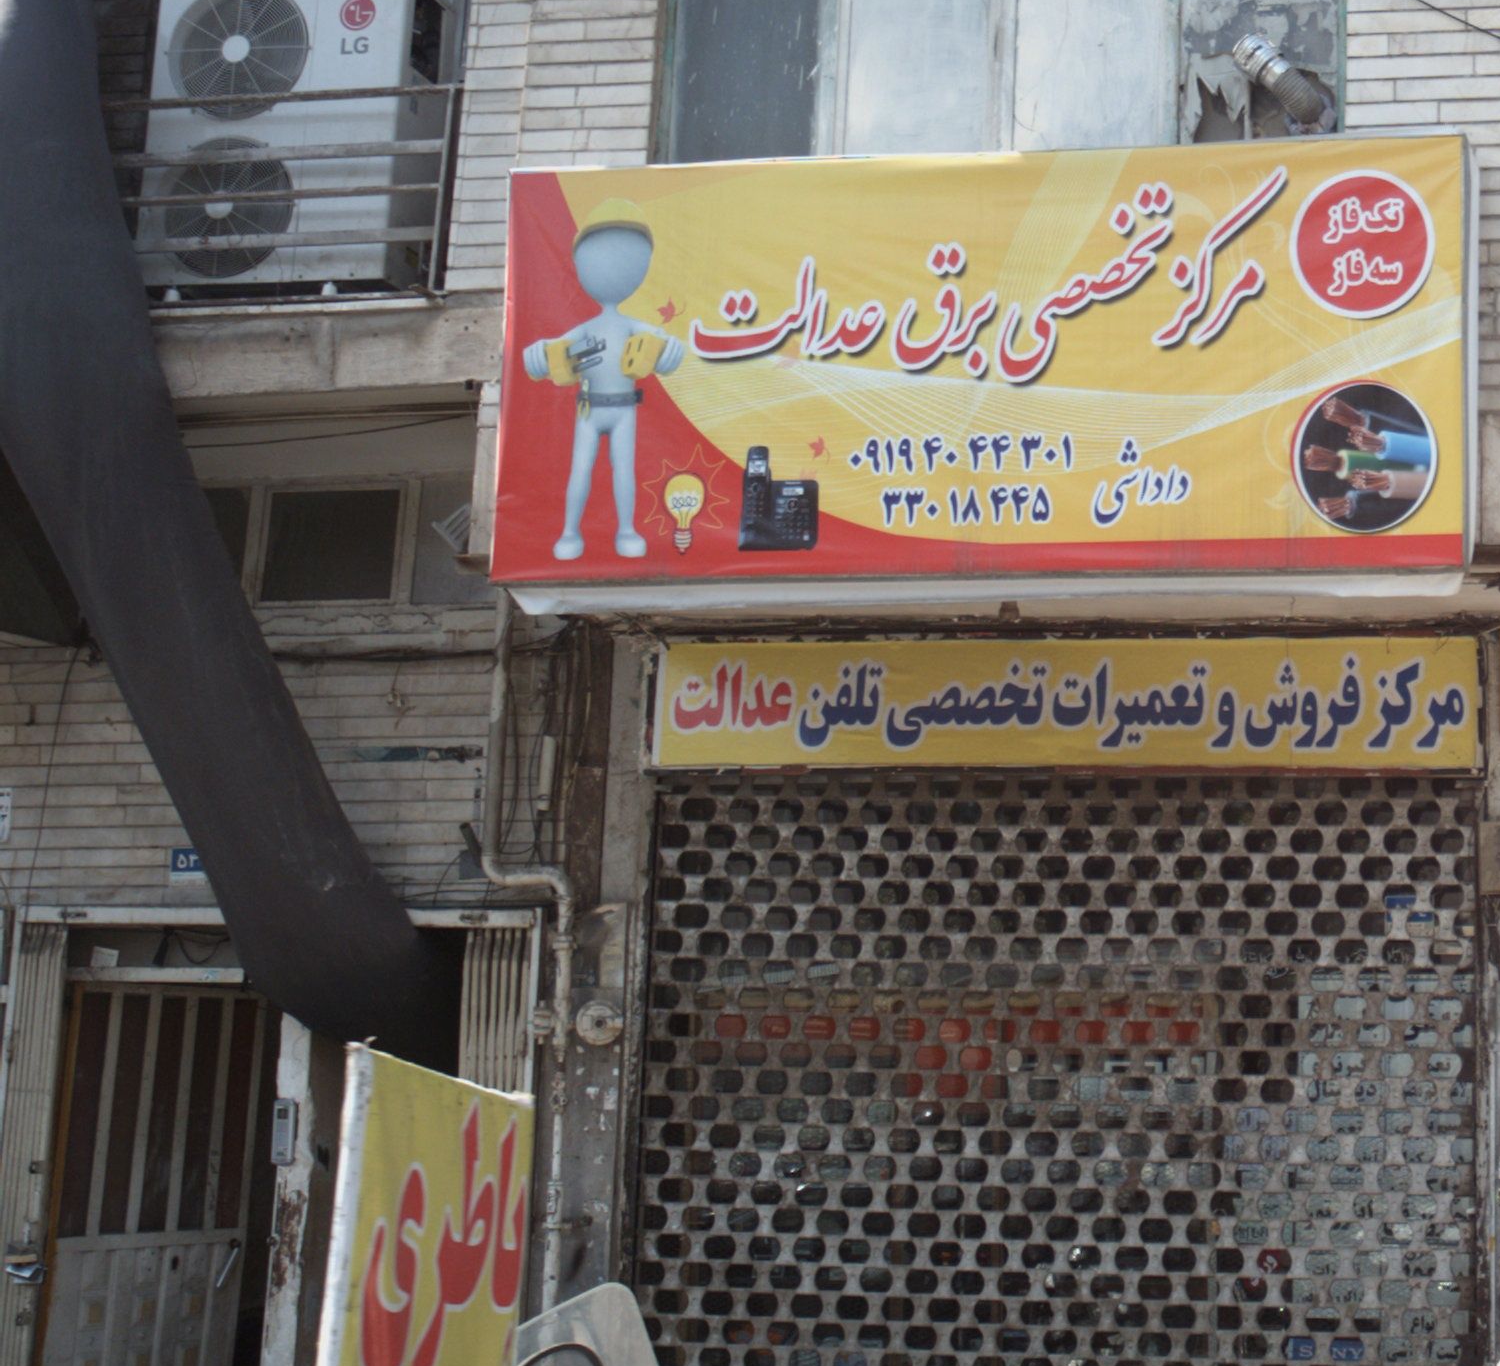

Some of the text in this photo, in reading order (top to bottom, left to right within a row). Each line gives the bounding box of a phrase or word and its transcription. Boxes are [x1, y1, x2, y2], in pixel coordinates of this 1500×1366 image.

[340, 36, 369, 55] LG
[1322, 197, 1404, 243] تک فاز
[692, 167, 1286, 380] مرکز تخصصی برق عدالت
[1327, 248, 1403, 296] سه فاز
[1092, 436, 1192, 526] داداشی
[673, 656, 1465, 749] مرکز فروش و تعمیرات تخصصی تلفن عدالت
[1299, 1345, 1364, 1359] SNY
